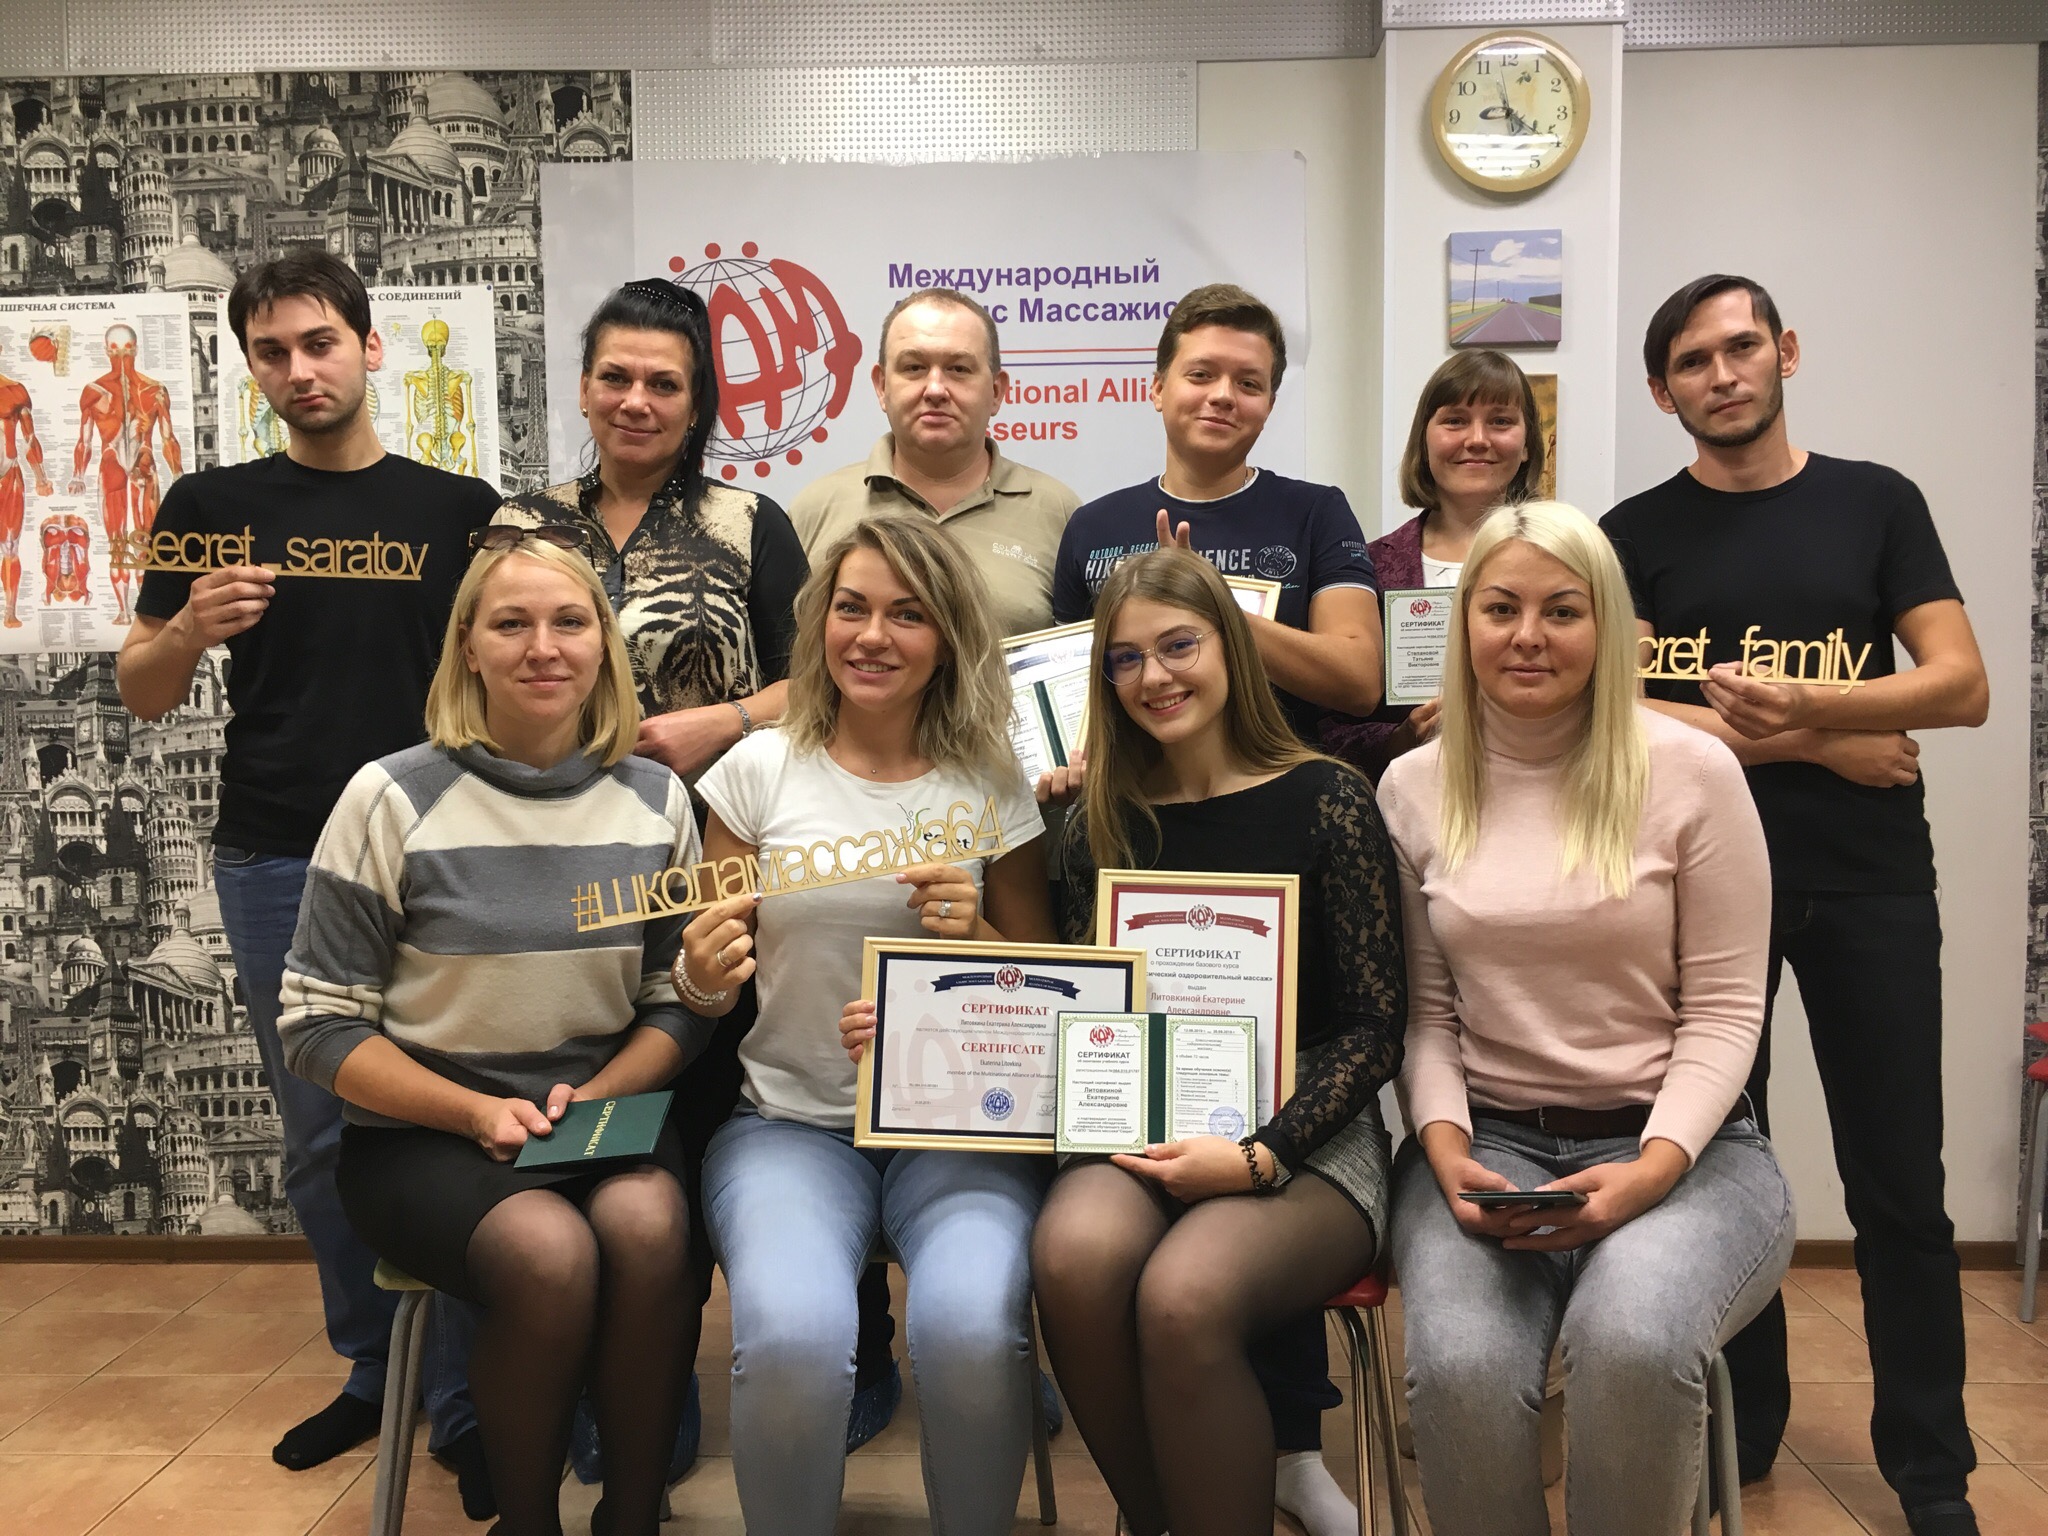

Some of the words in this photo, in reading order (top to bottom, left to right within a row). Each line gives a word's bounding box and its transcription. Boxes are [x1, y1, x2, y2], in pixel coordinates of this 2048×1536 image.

[1501, 53, 1519, 67] 12
[1533, 59, 1540, 73] 1
[1476, 60, 1491, 75] 11
[1457, 81, 1477, 96] 10
[1550, 77, 1562, 93] 2
[1448, 108, 1461, 125] 9
[1556, 105, 1568, 121] 3
[1529, 154, 1541, 169] 5
[888, 257, 1160, 293] Международный
[378, 290, 462, 302] СОЕДИНЕНИЙ
[60, 301, 116, 311] СИСТЕМА
[1097, 377, 1154, 403] Alli
[1090, 546, 1124, 559] OUTDOOR
[1198, 548, 1251, 571] ENCE
[1085, 557, 1124, 580] HIK
[1400, 620, 1445, 628] СЕРТИФИКАТ
[1155, 947, 1241, 960] СЕРТИФИКАТ
[1178, 972, 1241, 981] оздоровительный
[1150, 992, 1200, 1003] Литовкиной
[1202, 995, 1246, 1006] Екатерине
[961, 1003, 1050, 1016] СЕРТИФИКАТ
[986, 1020, 1010, 1028] Екатерина
[961, 1042, 1046, 1055] CERTIFICATE
[1077, 1051, 1131, 1059] СЕРТИФИКАТ
[583, 1100, 616, 1157] СЕРТИФИКАТ
